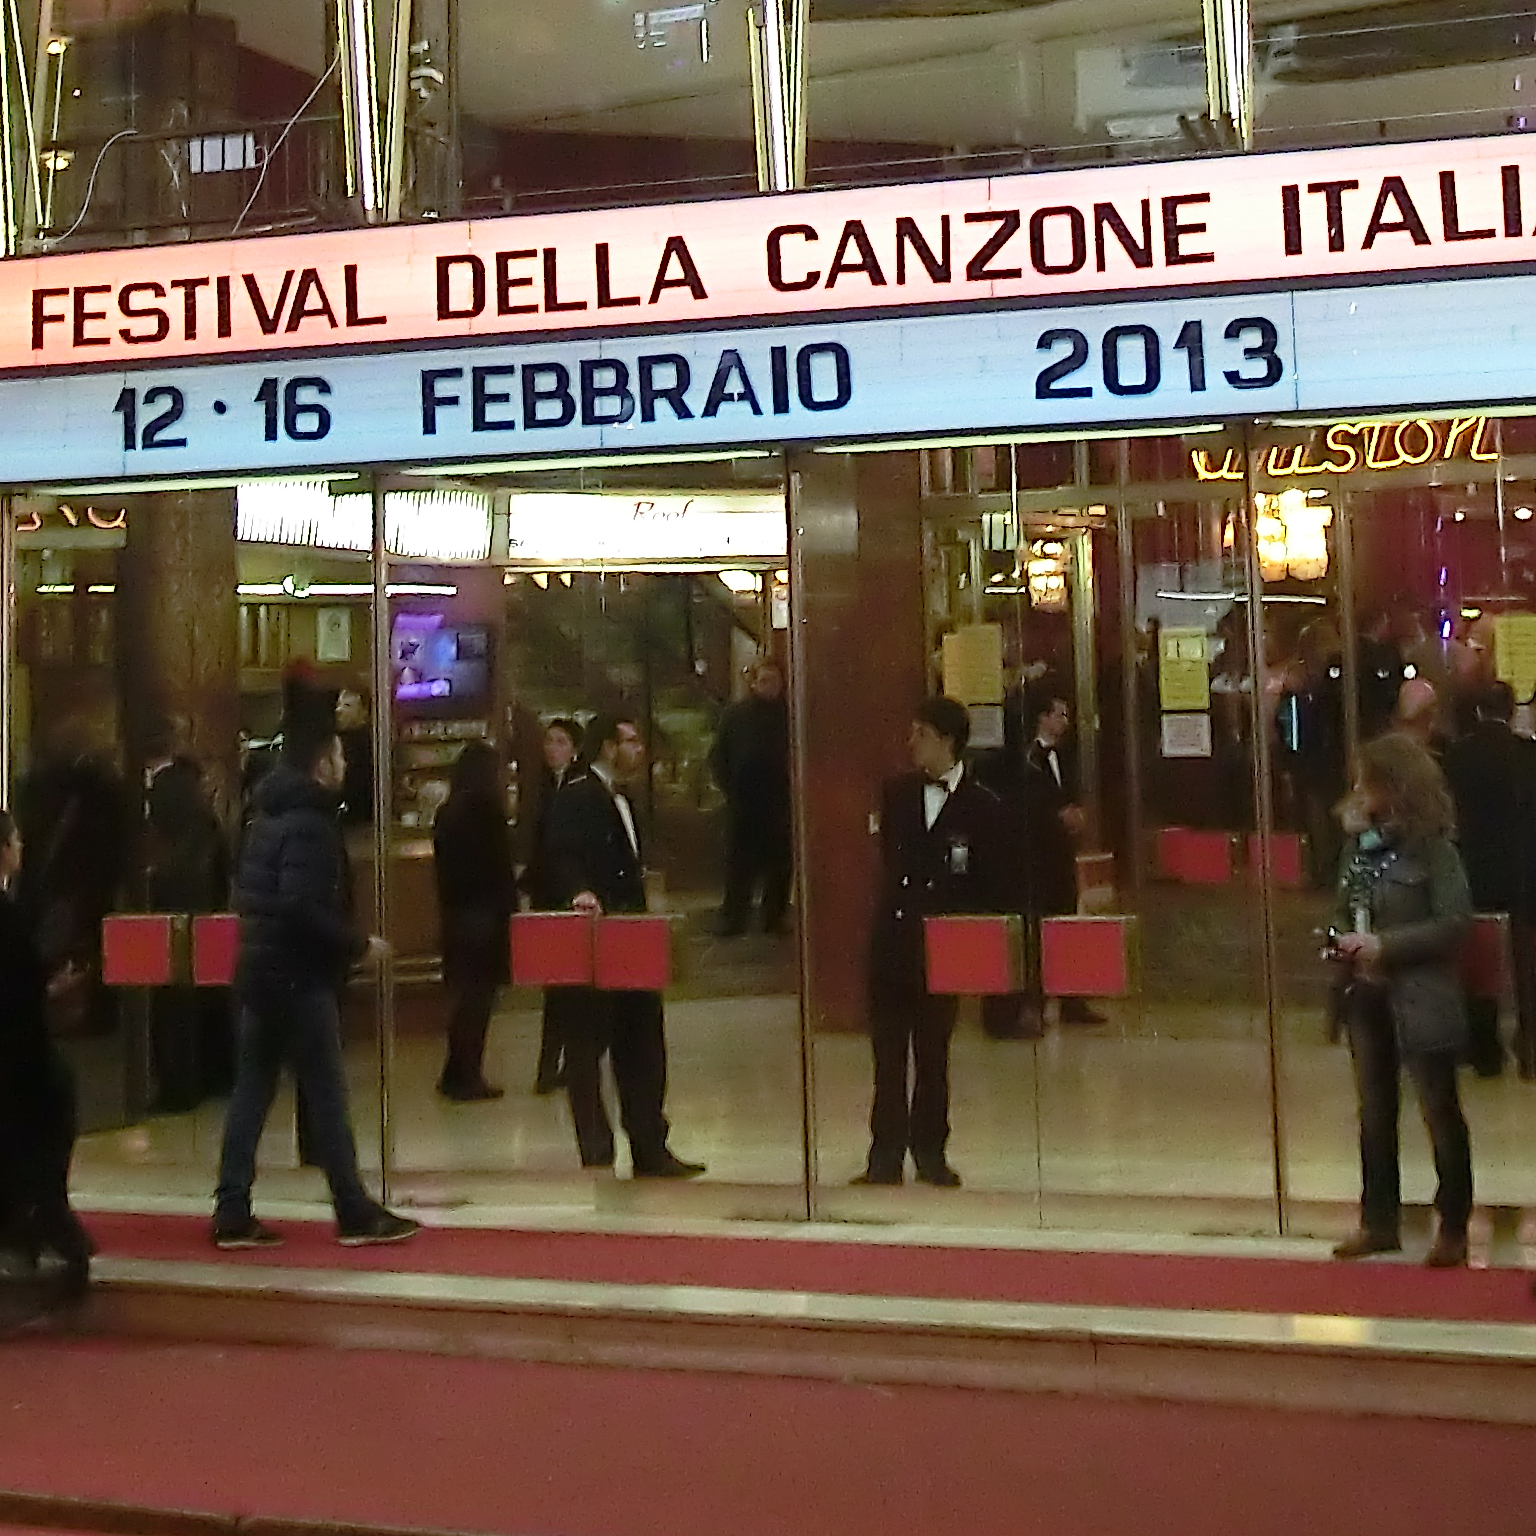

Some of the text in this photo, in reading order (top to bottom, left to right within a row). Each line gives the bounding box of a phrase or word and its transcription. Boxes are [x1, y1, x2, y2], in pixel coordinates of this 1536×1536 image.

[30, 263, 388, 351] FESTIVAL
[435, 235, 708, 322] DELLA
[766, 191, 1217, 295] CANZONE
[419, 341, 853, 437] FEBBRAIO
[1034, 316, 1285, 401] 2013
